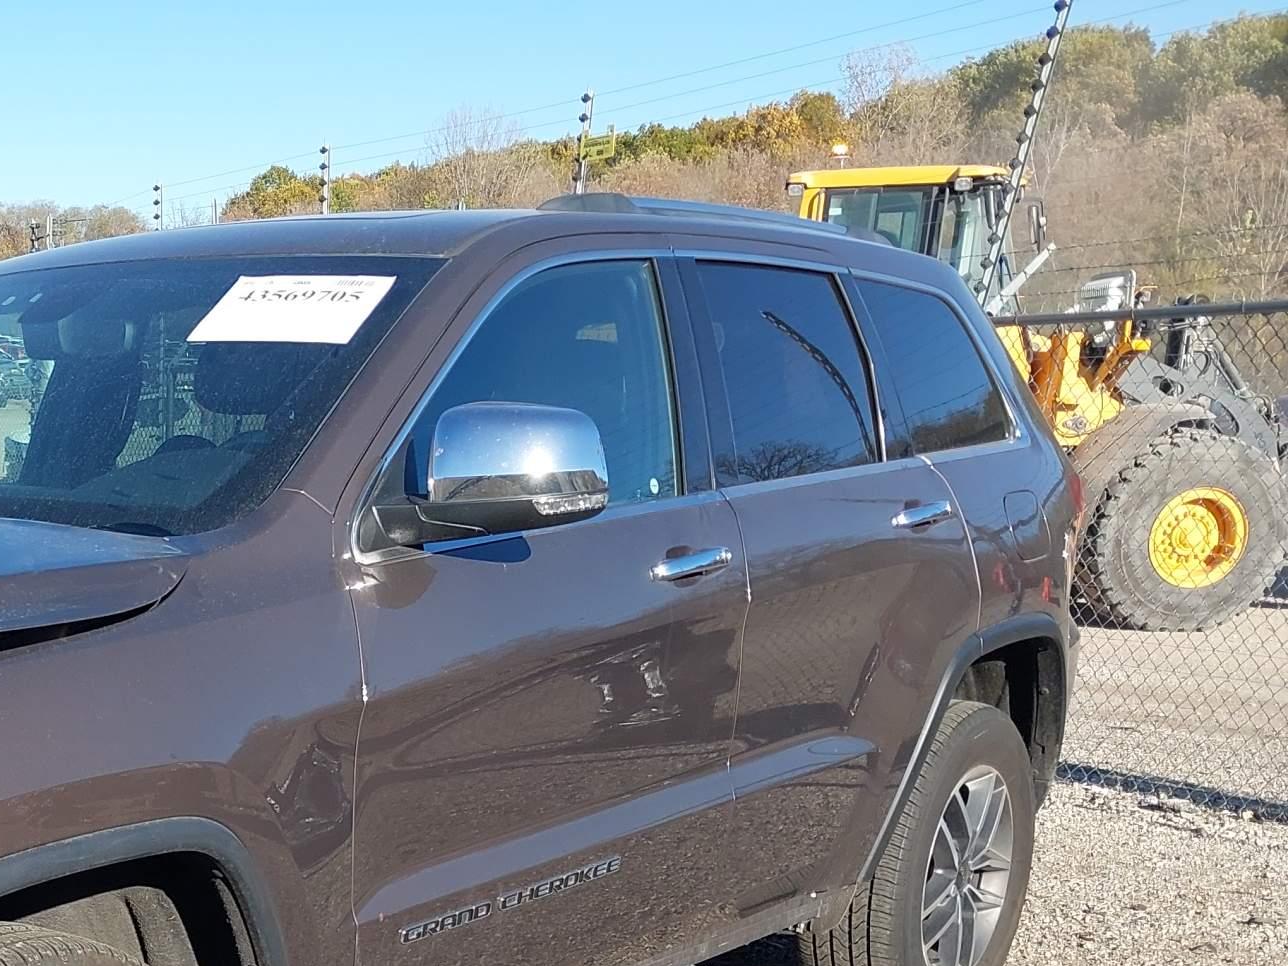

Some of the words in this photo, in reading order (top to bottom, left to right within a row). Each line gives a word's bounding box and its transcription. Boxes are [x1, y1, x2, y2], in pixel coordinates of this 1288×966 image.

[239, 289, 365, 302] 43569705
[400, 901, 493, 945] GRAND
[497, 856, 622, 911] CHEROKEE
